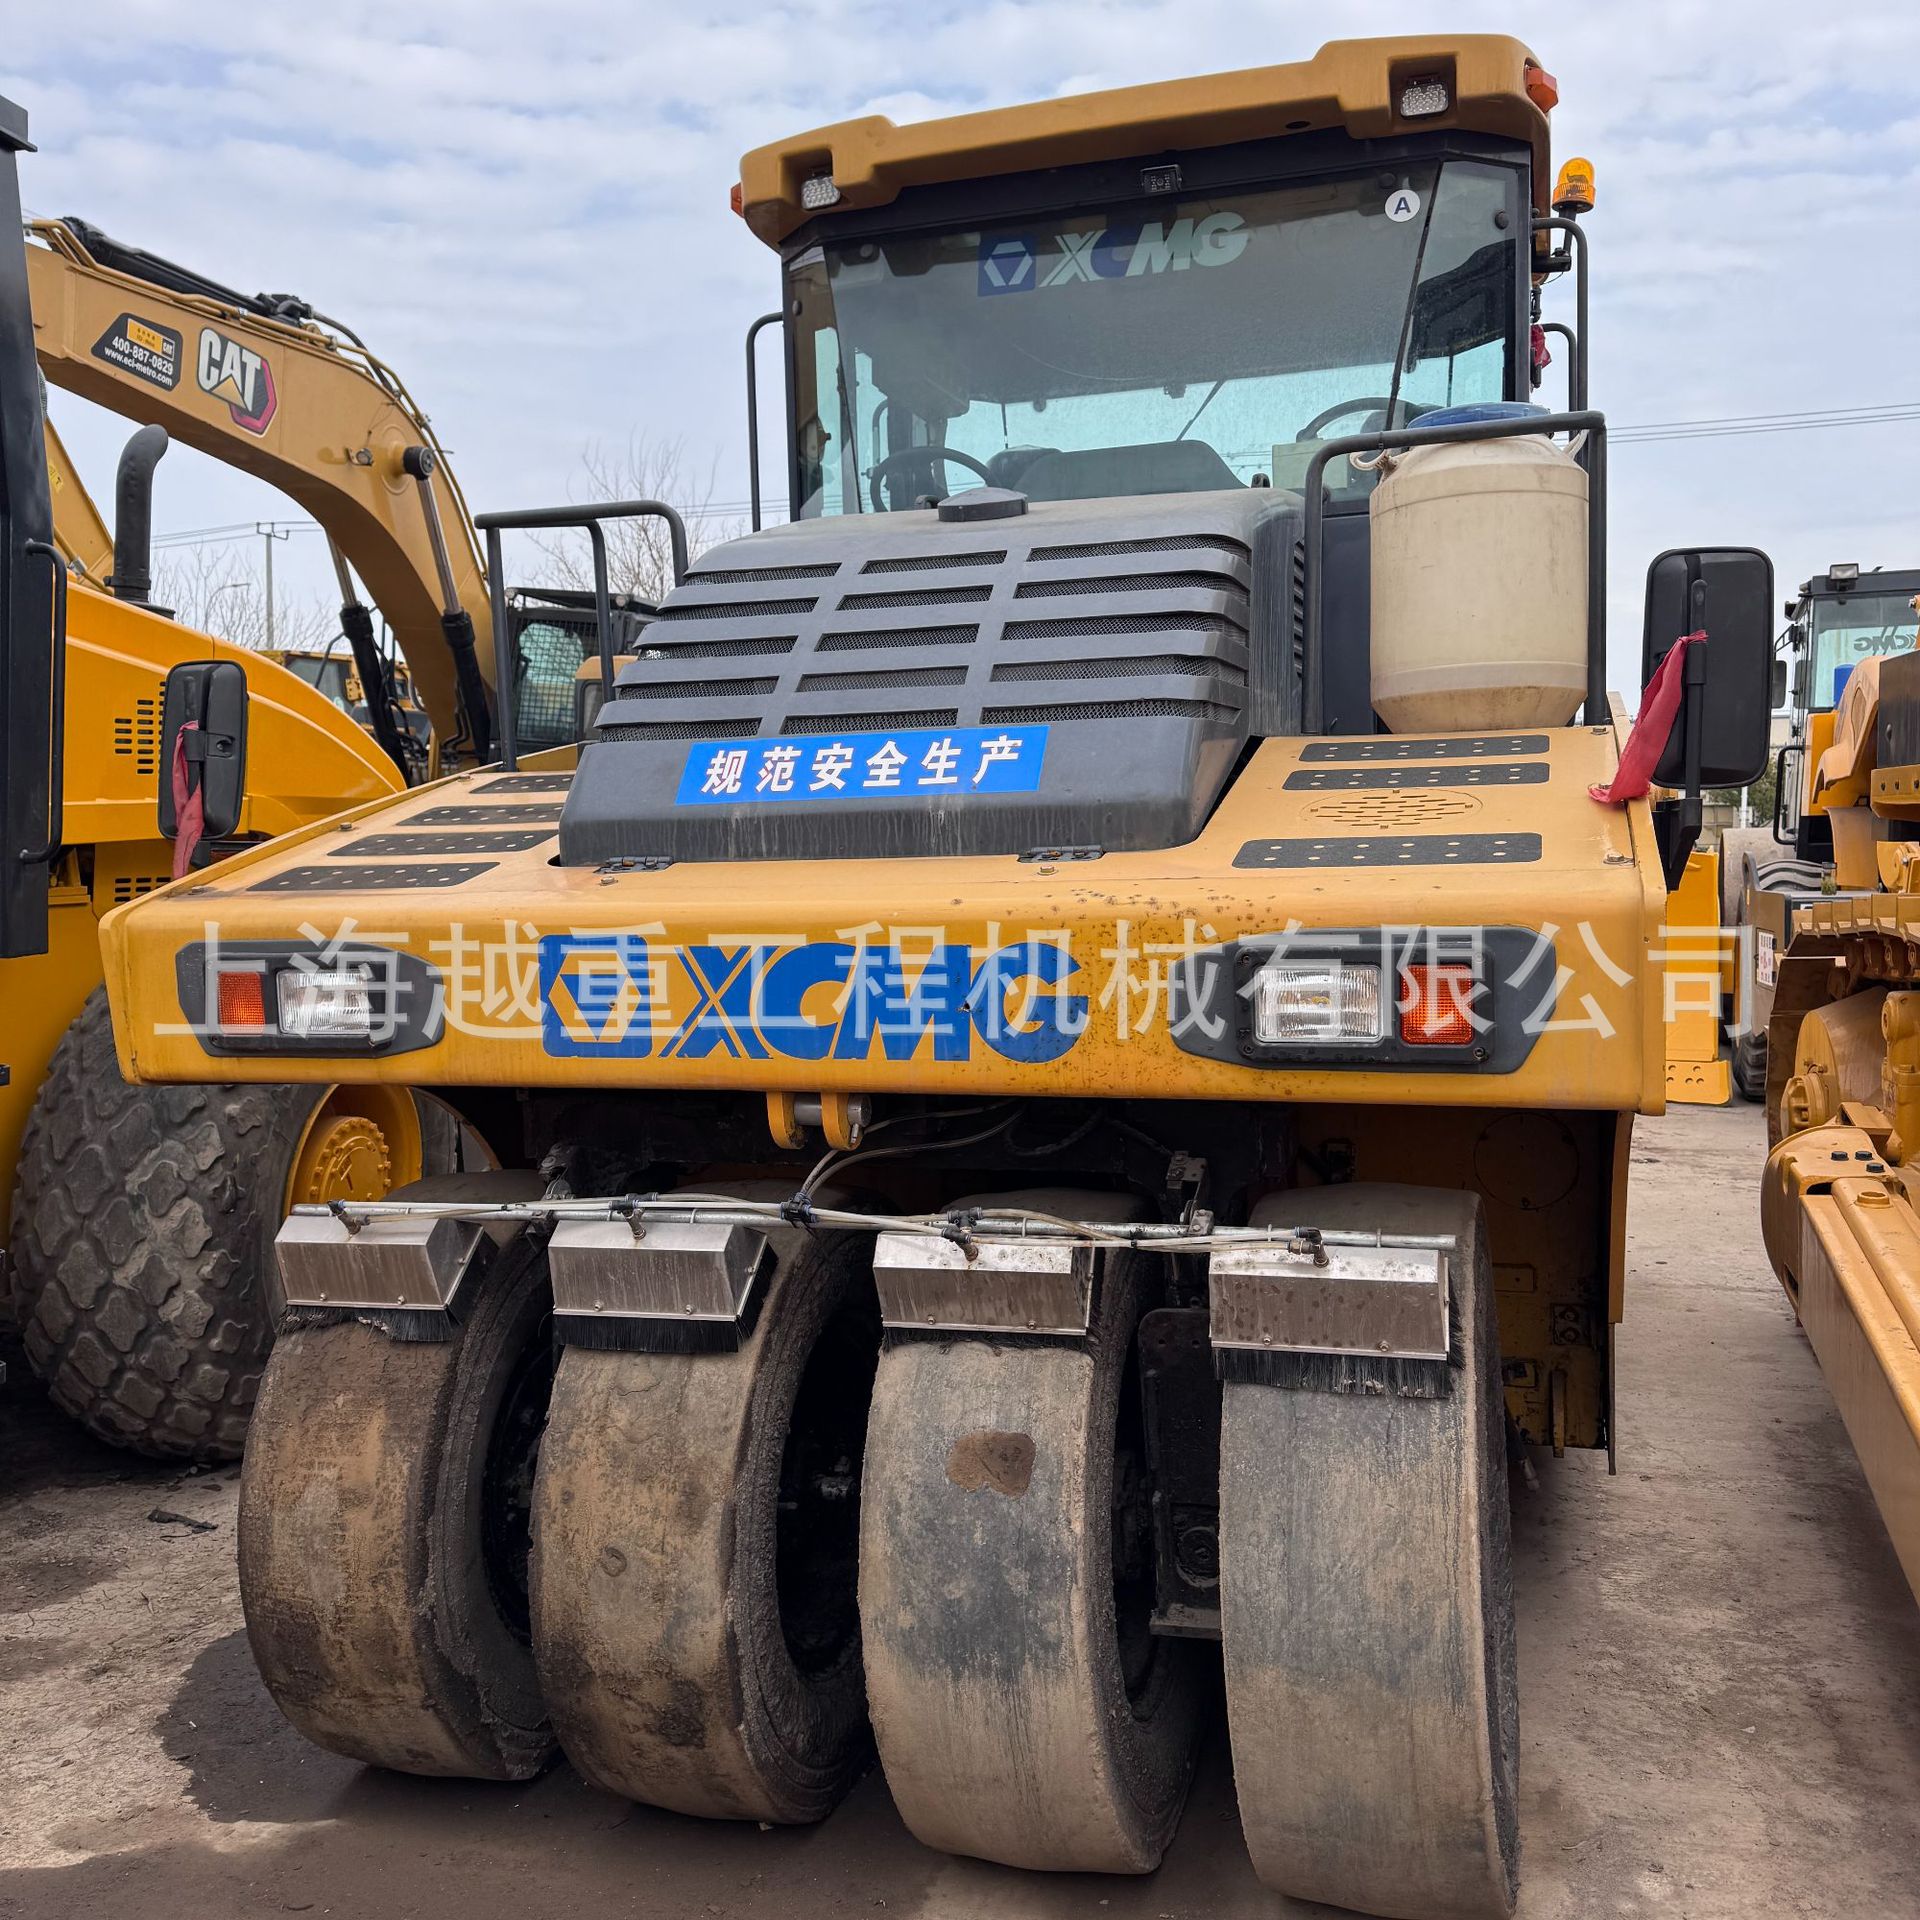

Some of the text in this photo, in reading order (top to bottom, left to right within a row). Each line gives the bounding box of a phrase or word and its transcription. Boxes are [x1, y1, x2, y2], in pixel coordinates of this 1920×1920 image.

[1392, 196, 1412, 216] A
[1038, 211, 1250, 288] XCMG
[112, 335, 174, 376] 400-887-0829
[199, 328, 261, 412] CAT
[701, 735, 1022, 795] 规范安全生产
[658, 942, 1090, 1064] XCMG
